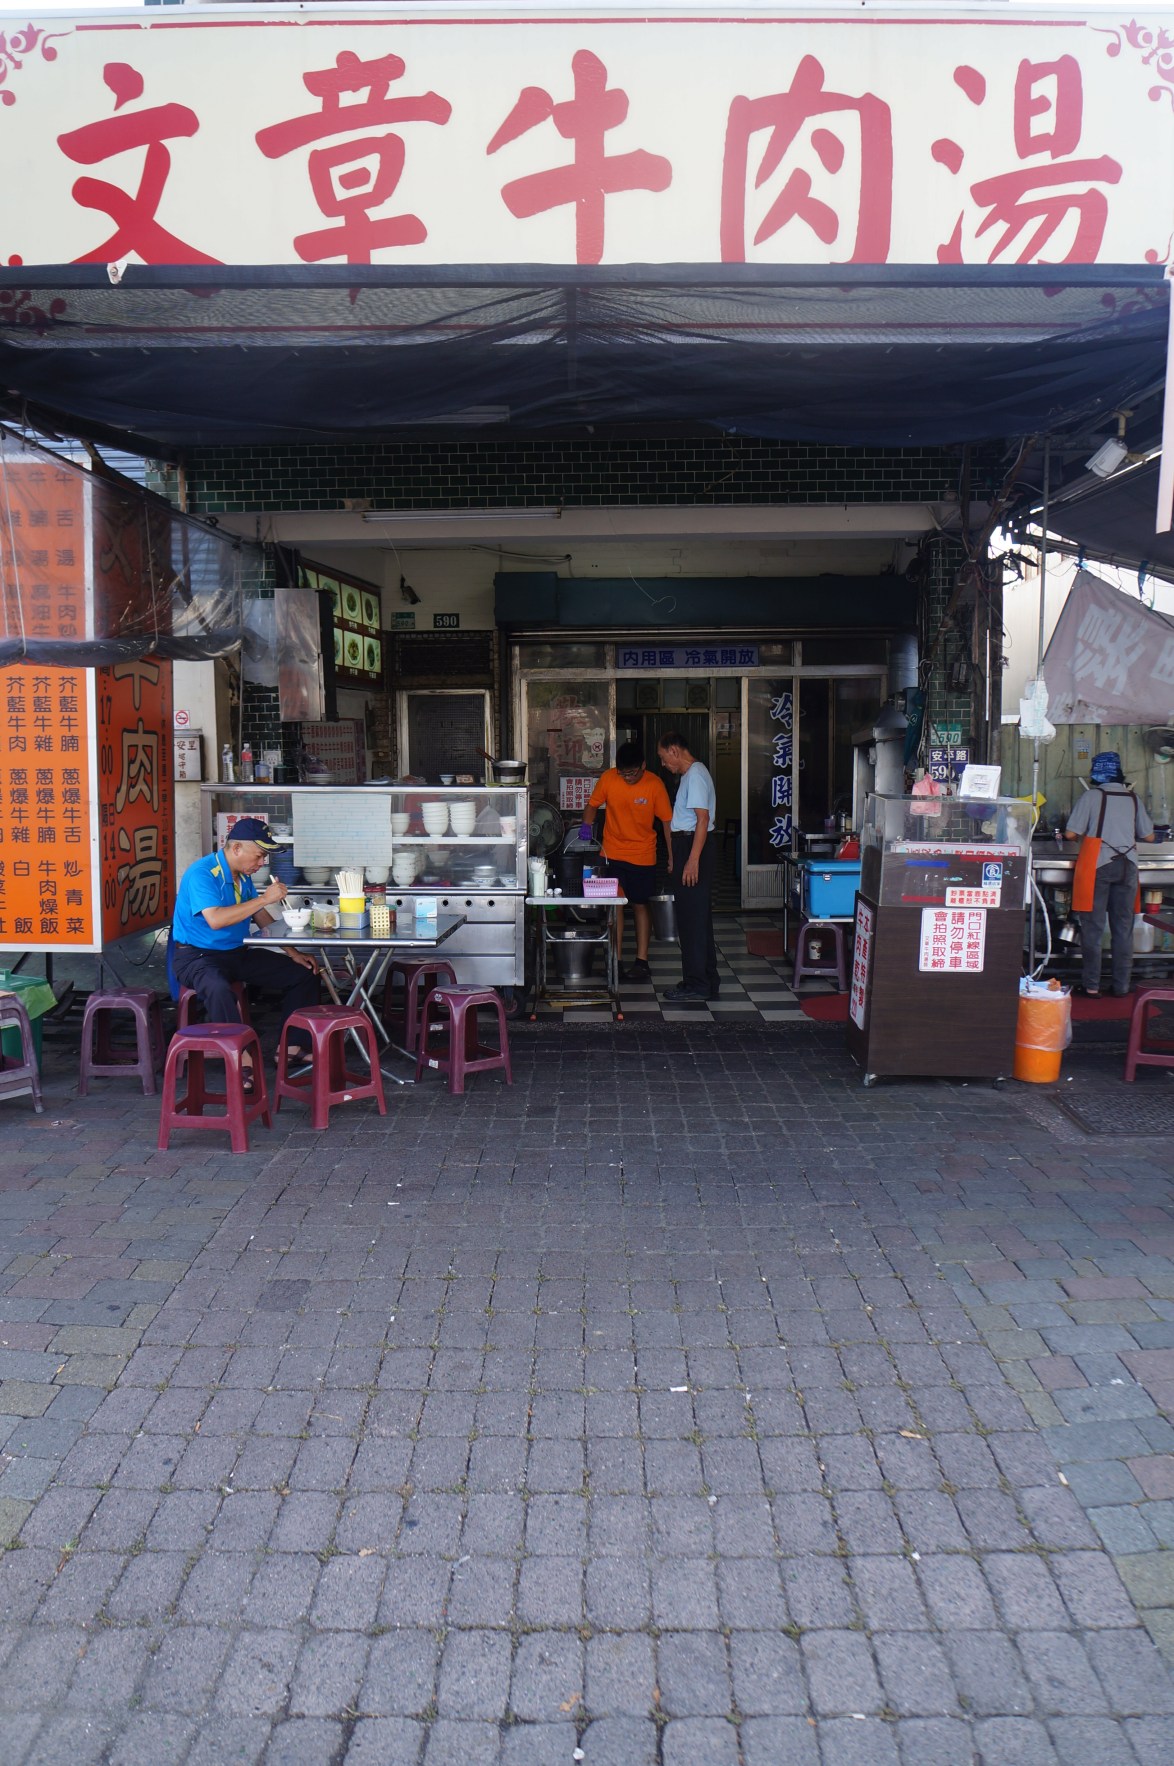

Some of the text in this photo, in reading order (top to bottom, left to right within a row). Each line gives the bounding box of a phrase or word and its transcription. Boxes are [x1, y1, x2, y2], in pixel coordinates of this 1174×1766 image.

[56, 51, 1122, 267] 文章牛肉湯
[436, 615, 457, 627] 590
[685, 649, 755, 665] 冷氣開放
[6, 676, 26, 752] 芥藍牛肉
[32, 676, 53, 752] 芥藍牛雜
[59, 676, 79, 752] 芥藍牛腩
[938, 732, 960, 744] 590
[932, 750, 967, 761] 安平路
[9, 768, 30, 843] 蔥爆牛雜
[35, 768, 56, 843] 蔥爆牛腩
[62, 768, 82, 843] 蔥爆牛舌
[13, 860, 33, 934] 白飯
[38, 860, 59, 934] 牛肉燥飯
[64, 860, 84, 934] 炒青菜
[931, 911, 948, 968] 會拍照取締
[949, 912, 965, 968] 請勿停車
[966, 912, 982, 969] 門口紅線區域
